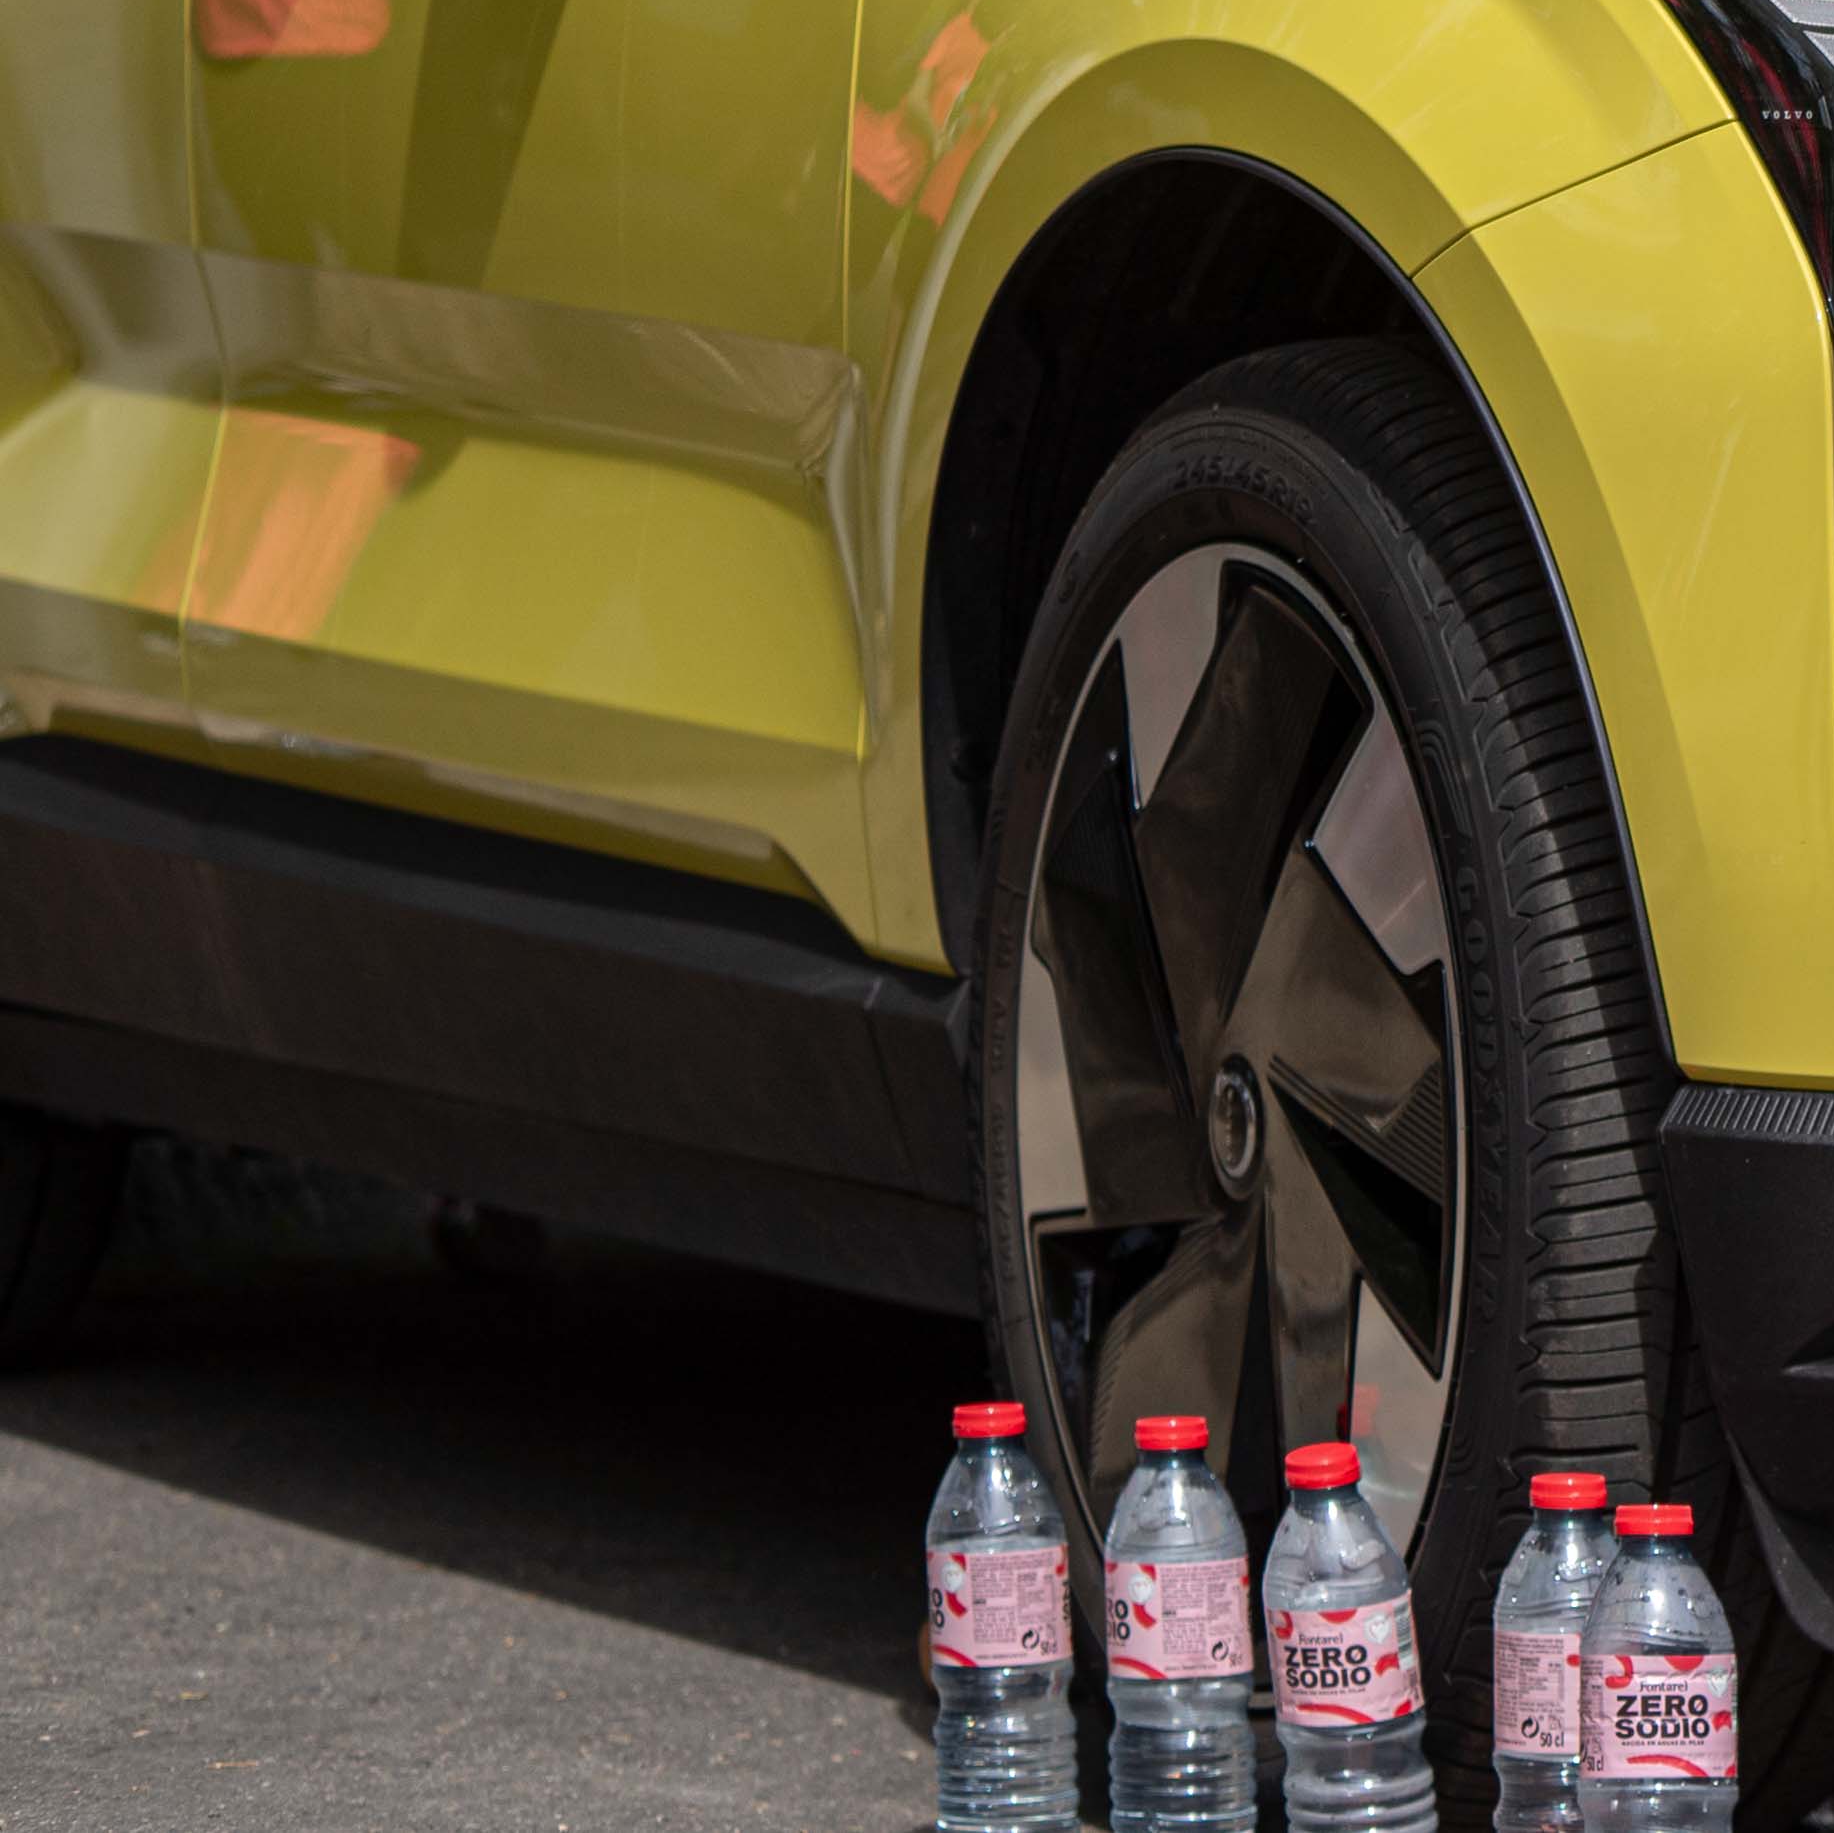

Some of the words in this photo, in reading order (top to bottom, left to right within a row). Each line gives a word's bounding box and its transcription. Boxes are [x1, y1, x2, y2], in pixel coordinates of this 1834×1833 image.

[1762, 110, 1813, 119] VOLVO
[1284, 1644, 1368, 1668] ZERO
[1286, 1666, 1372, 1689] SODIO
[1616, 1694, 1709, 1718] ZERO
[1540, 1732, 1553, 1748] 50
[1615, 1718, 1710, 1740] SODIO
